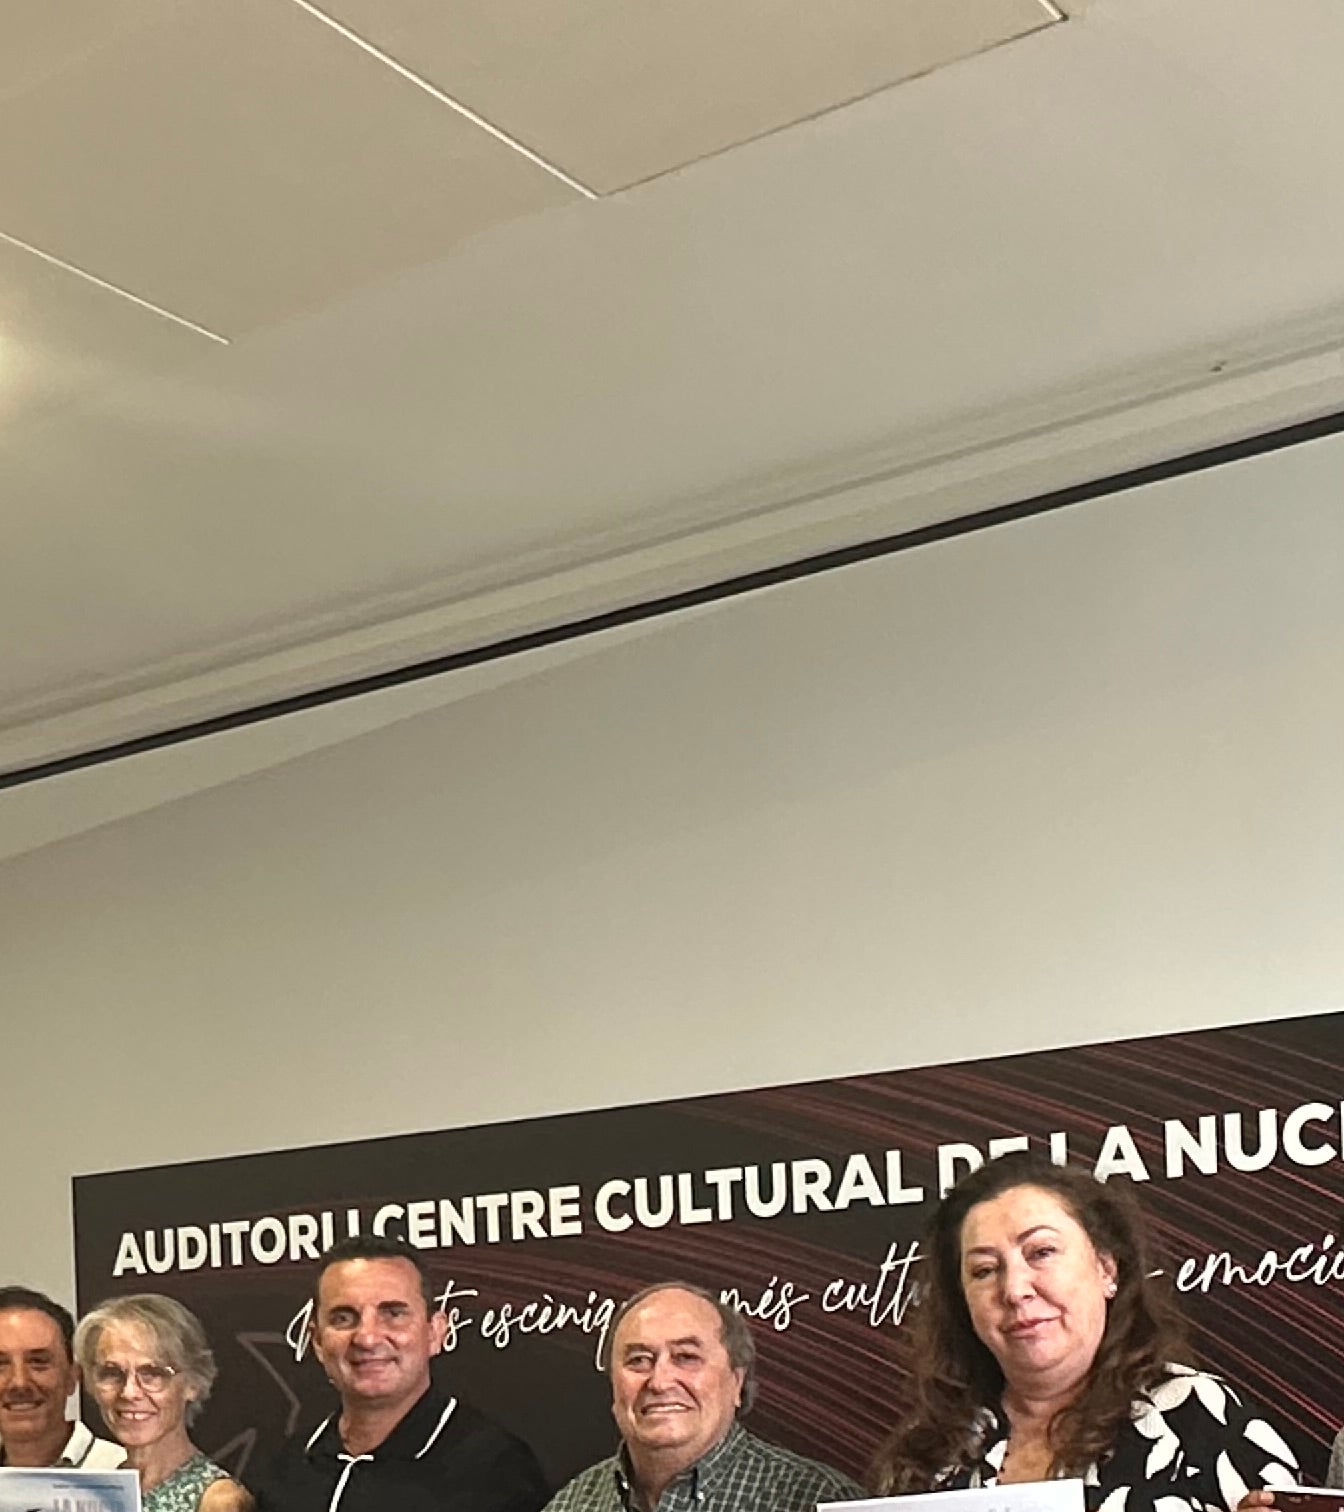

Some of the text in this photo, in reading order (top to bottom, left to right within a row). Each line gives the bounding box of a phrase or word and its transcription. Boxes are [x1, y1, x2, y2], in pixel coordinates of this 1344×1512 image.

[112, 1211, 334, 1277] AUDITORI
[372, 1186, 582, 1250] CENTRE
[594, 1148, 924, 1232] CULTURAL
